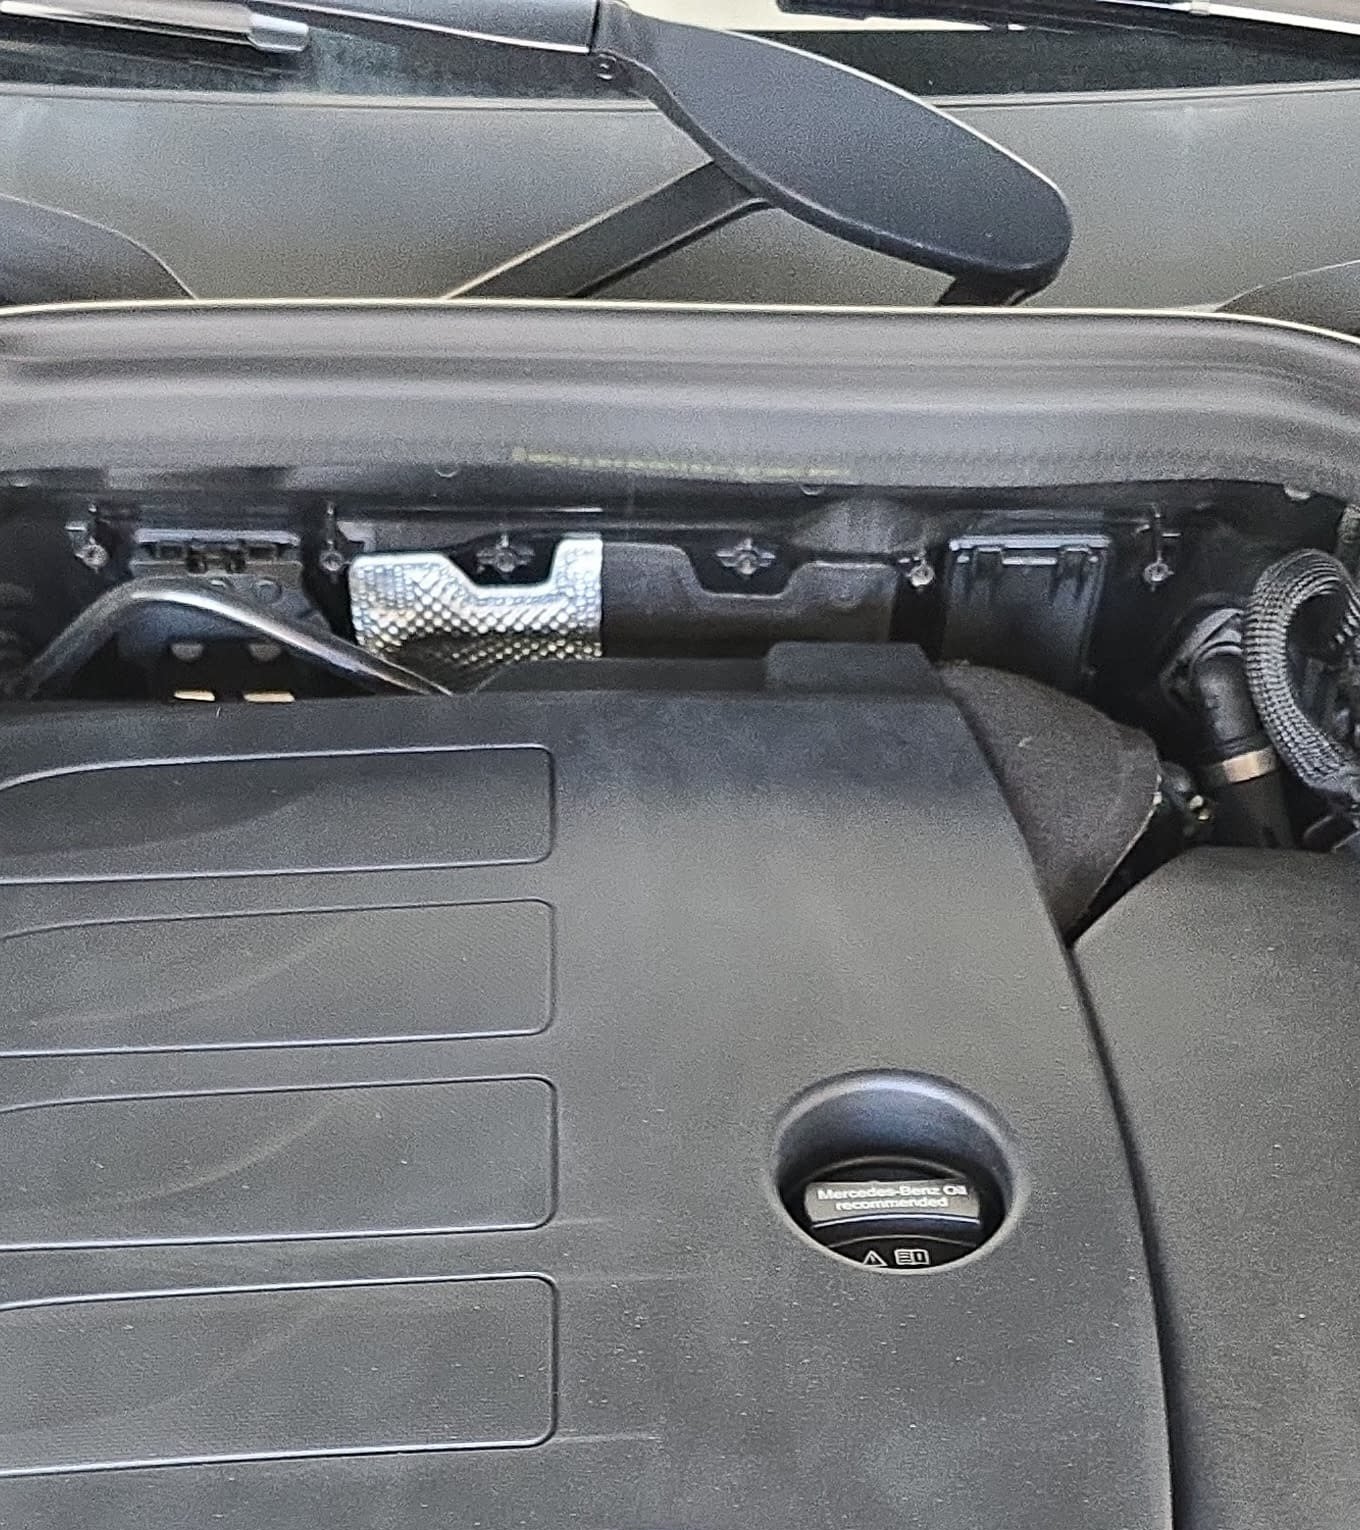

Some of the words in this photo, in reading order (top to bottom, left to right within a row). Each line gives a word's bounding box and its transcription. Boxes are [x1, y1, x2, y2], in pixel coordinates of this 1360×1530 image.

[817, 1186, 940, 1200] Mercedes-Benz
[943, 1185, 968, 1197] Oil
[835, 1198, 949, 1211] recommended
